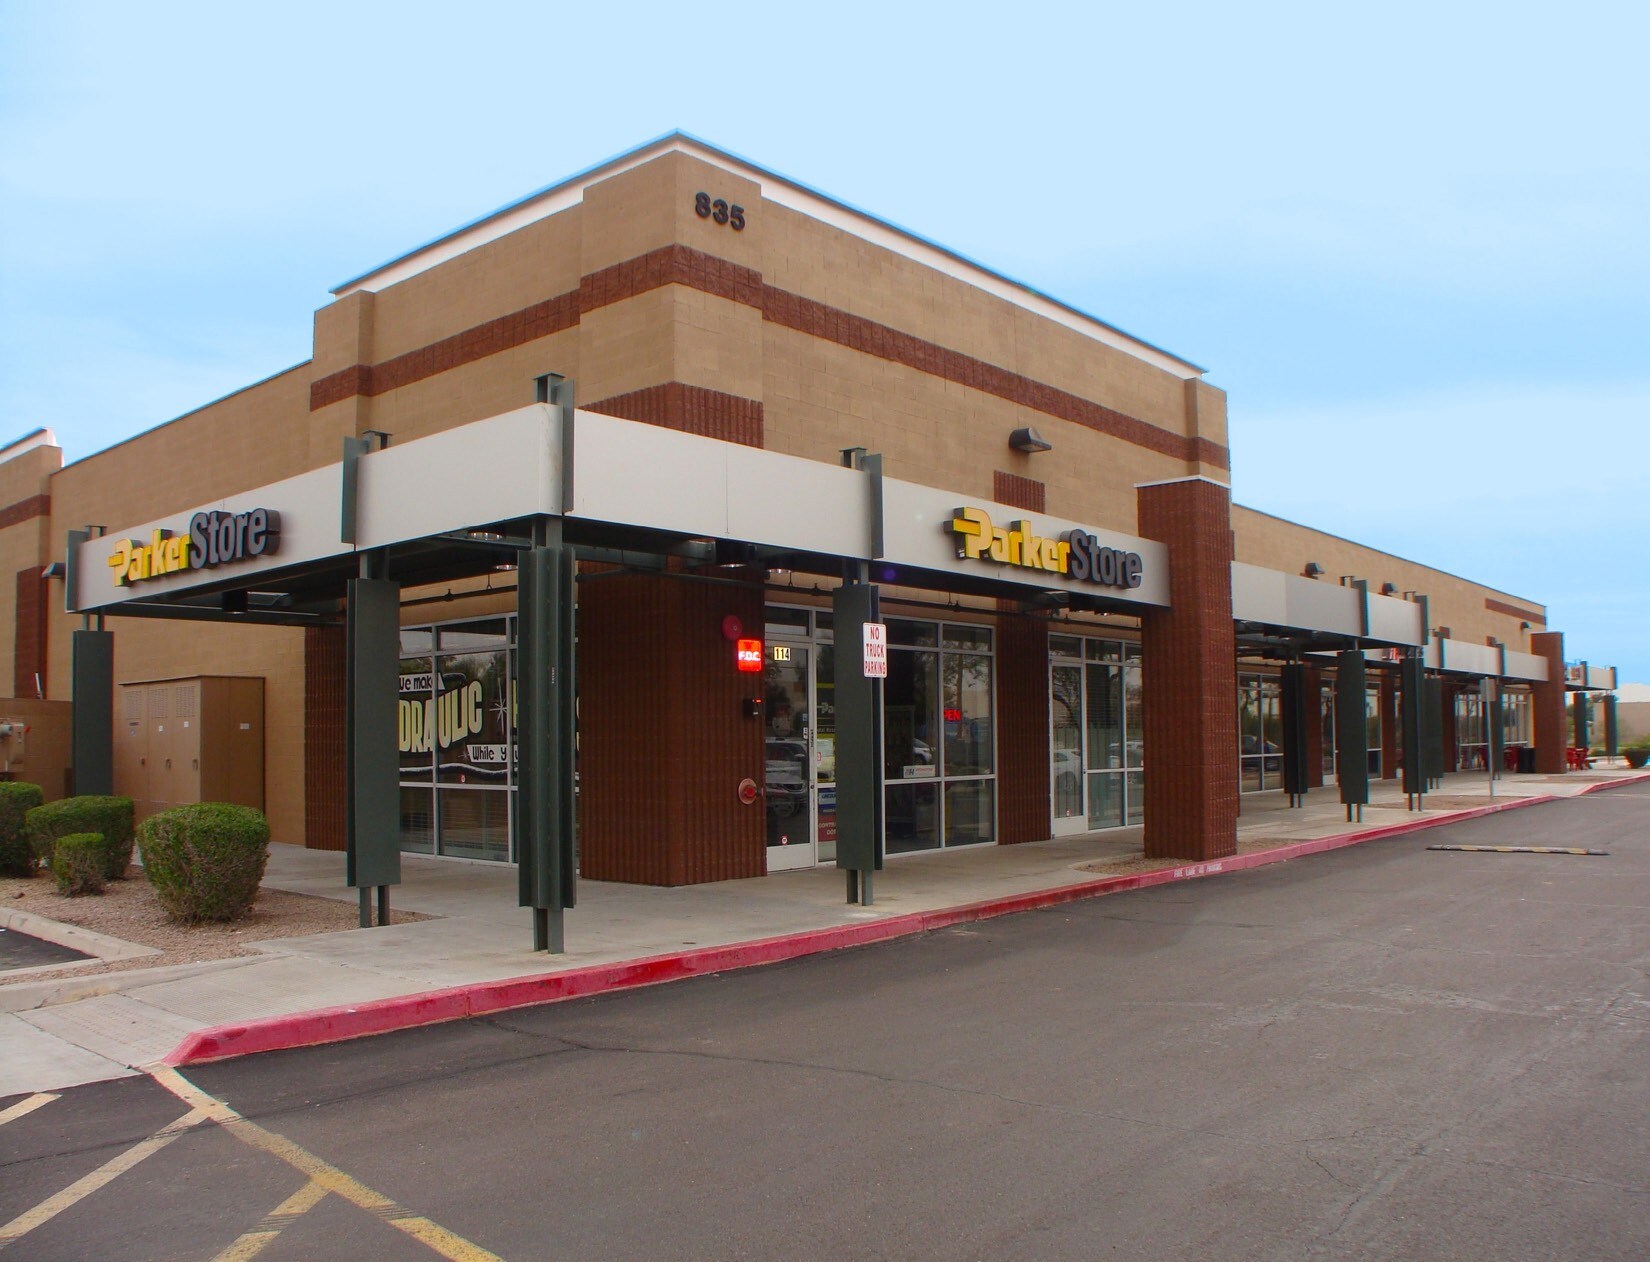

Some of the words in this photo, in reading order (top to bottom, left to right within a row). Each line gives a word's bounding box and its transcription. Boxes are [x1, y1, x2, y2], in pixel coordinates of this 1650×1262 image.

[695, 191, 746, 231] 835
[870, 626, 880, 640] NO
[776, 648, 790, 660] 114
[866, 643, 885, 658] TRUCK
[864, 660, 886, 675] PARKING
[413, 675, 433, 689] mak
[399, 680, 483, 753] DRAULIC
[472, 745, 495, 761] While
